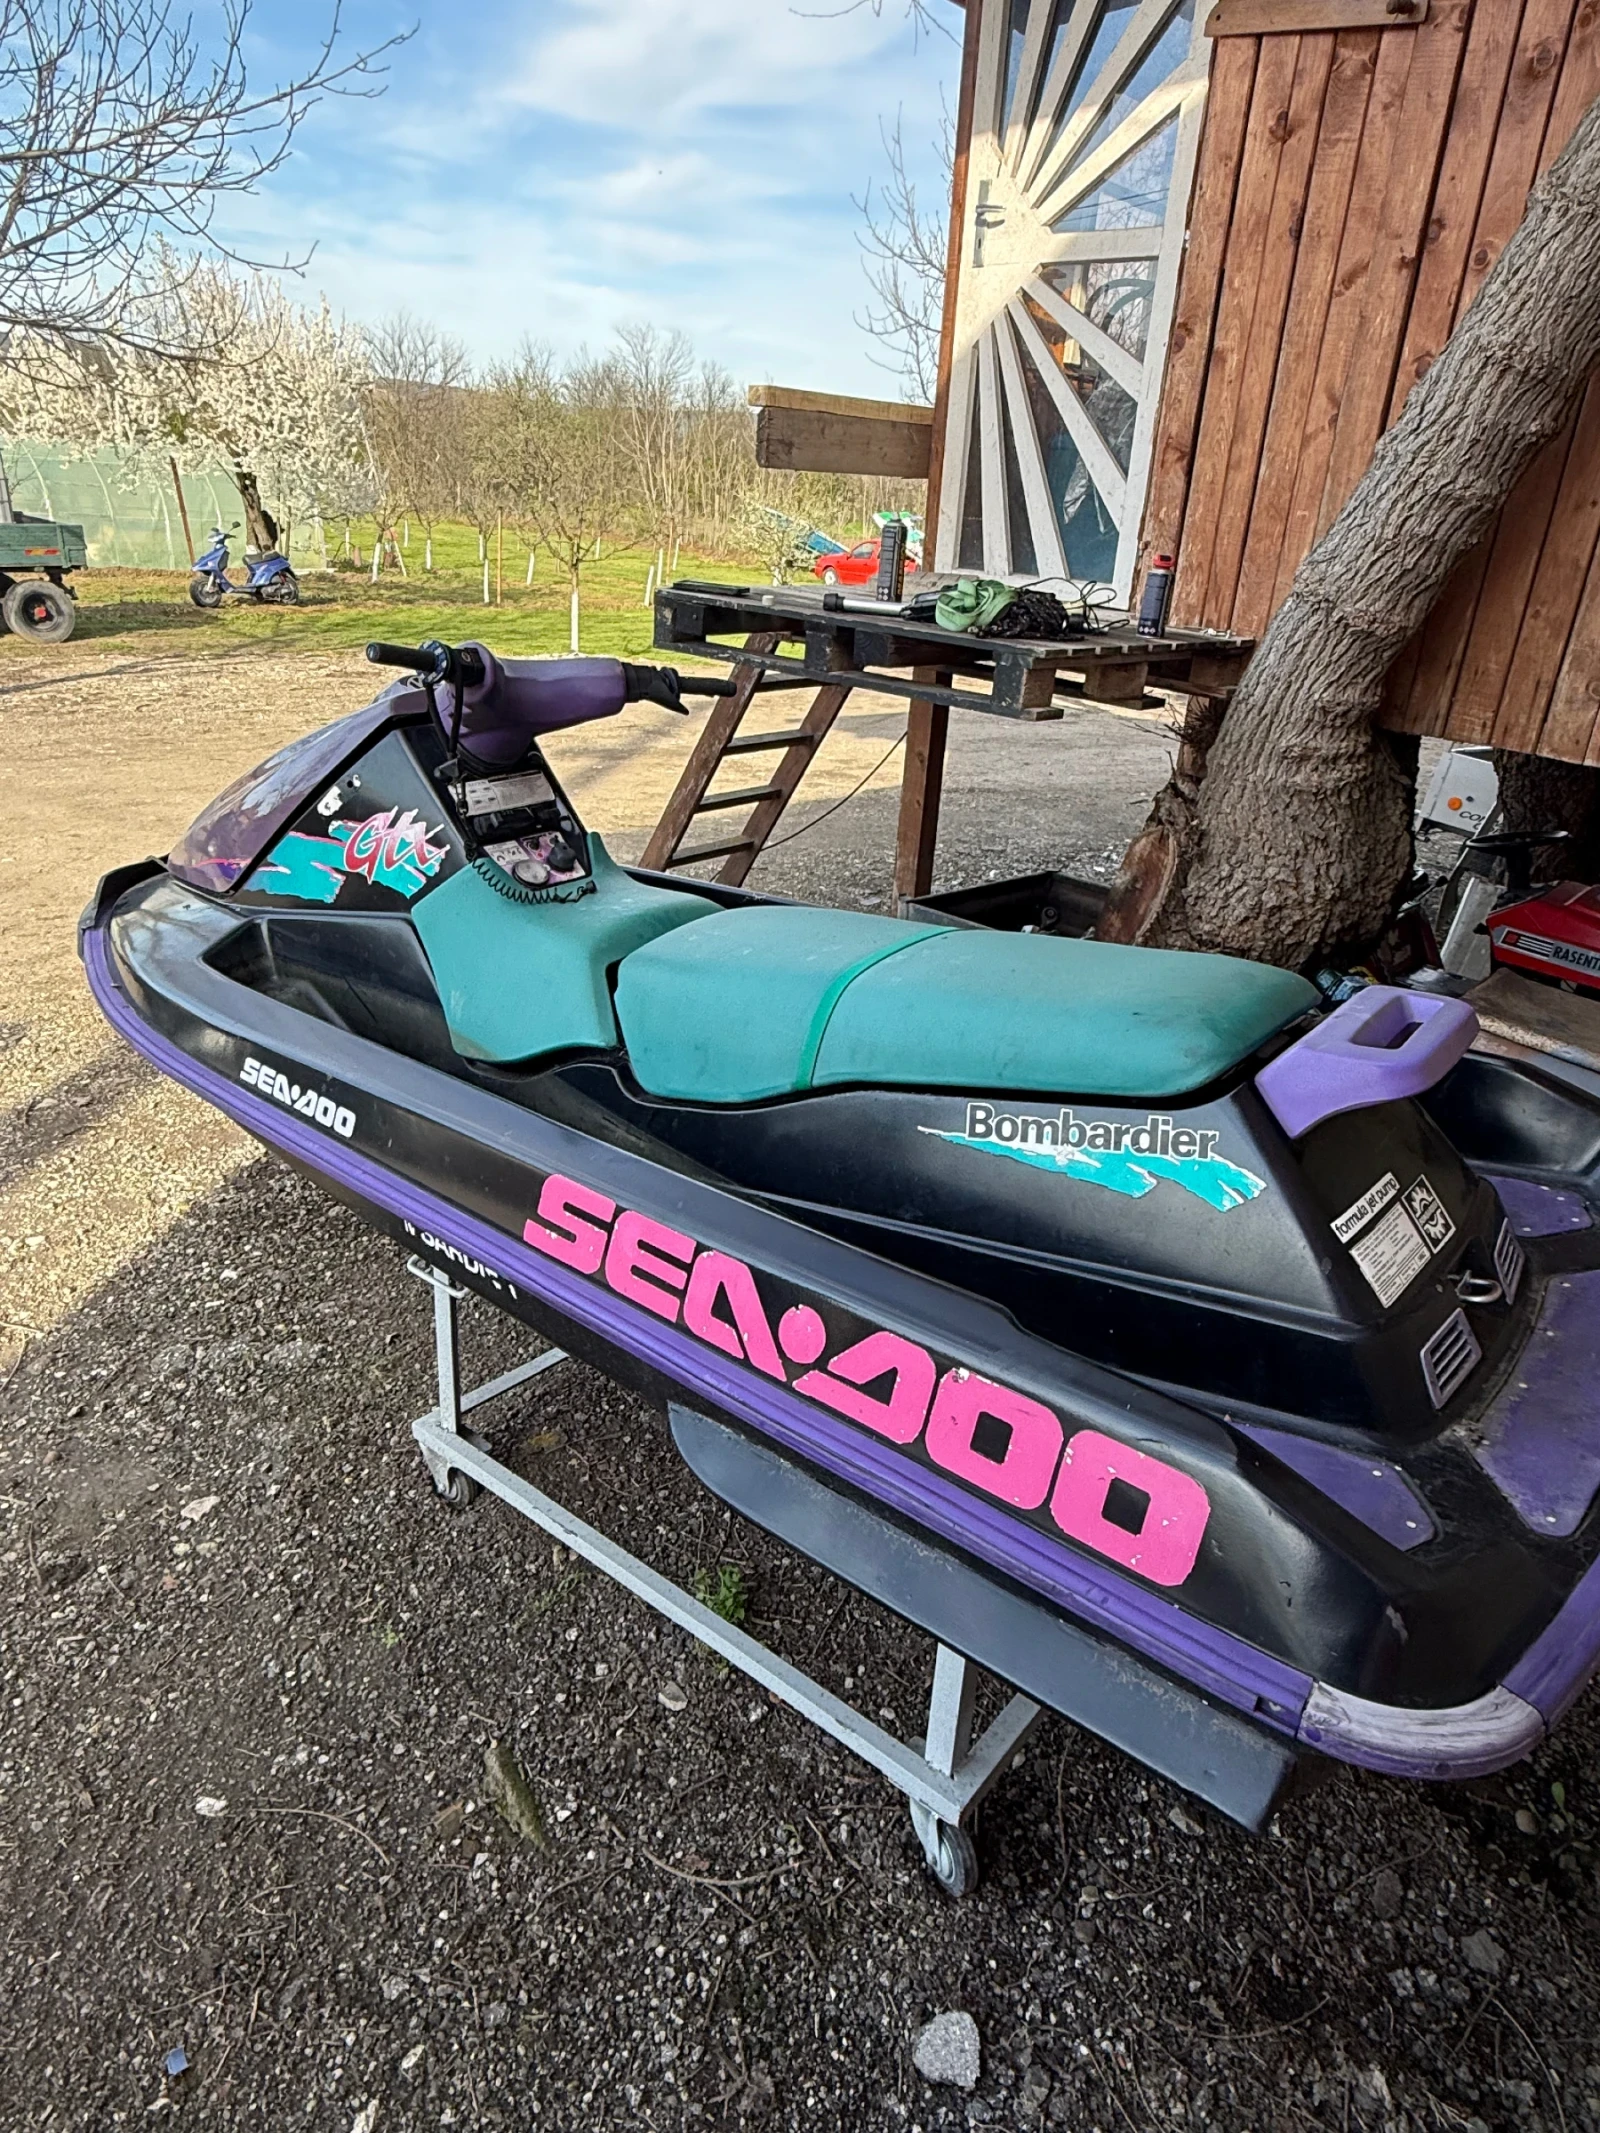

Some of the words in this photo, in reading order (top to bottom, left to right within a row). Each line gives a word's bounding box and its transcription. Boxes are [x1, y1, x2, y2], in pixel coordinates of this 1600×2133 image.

[1552, 946, 1600, 971] RASENT
[966, 1103, 1219, 1160] Bombardier
[1335, 1205, 1369, 1238] formula
[1364, 1192, 1379, 1214] jet
[1376, 1177, 1397, 1204] pump
